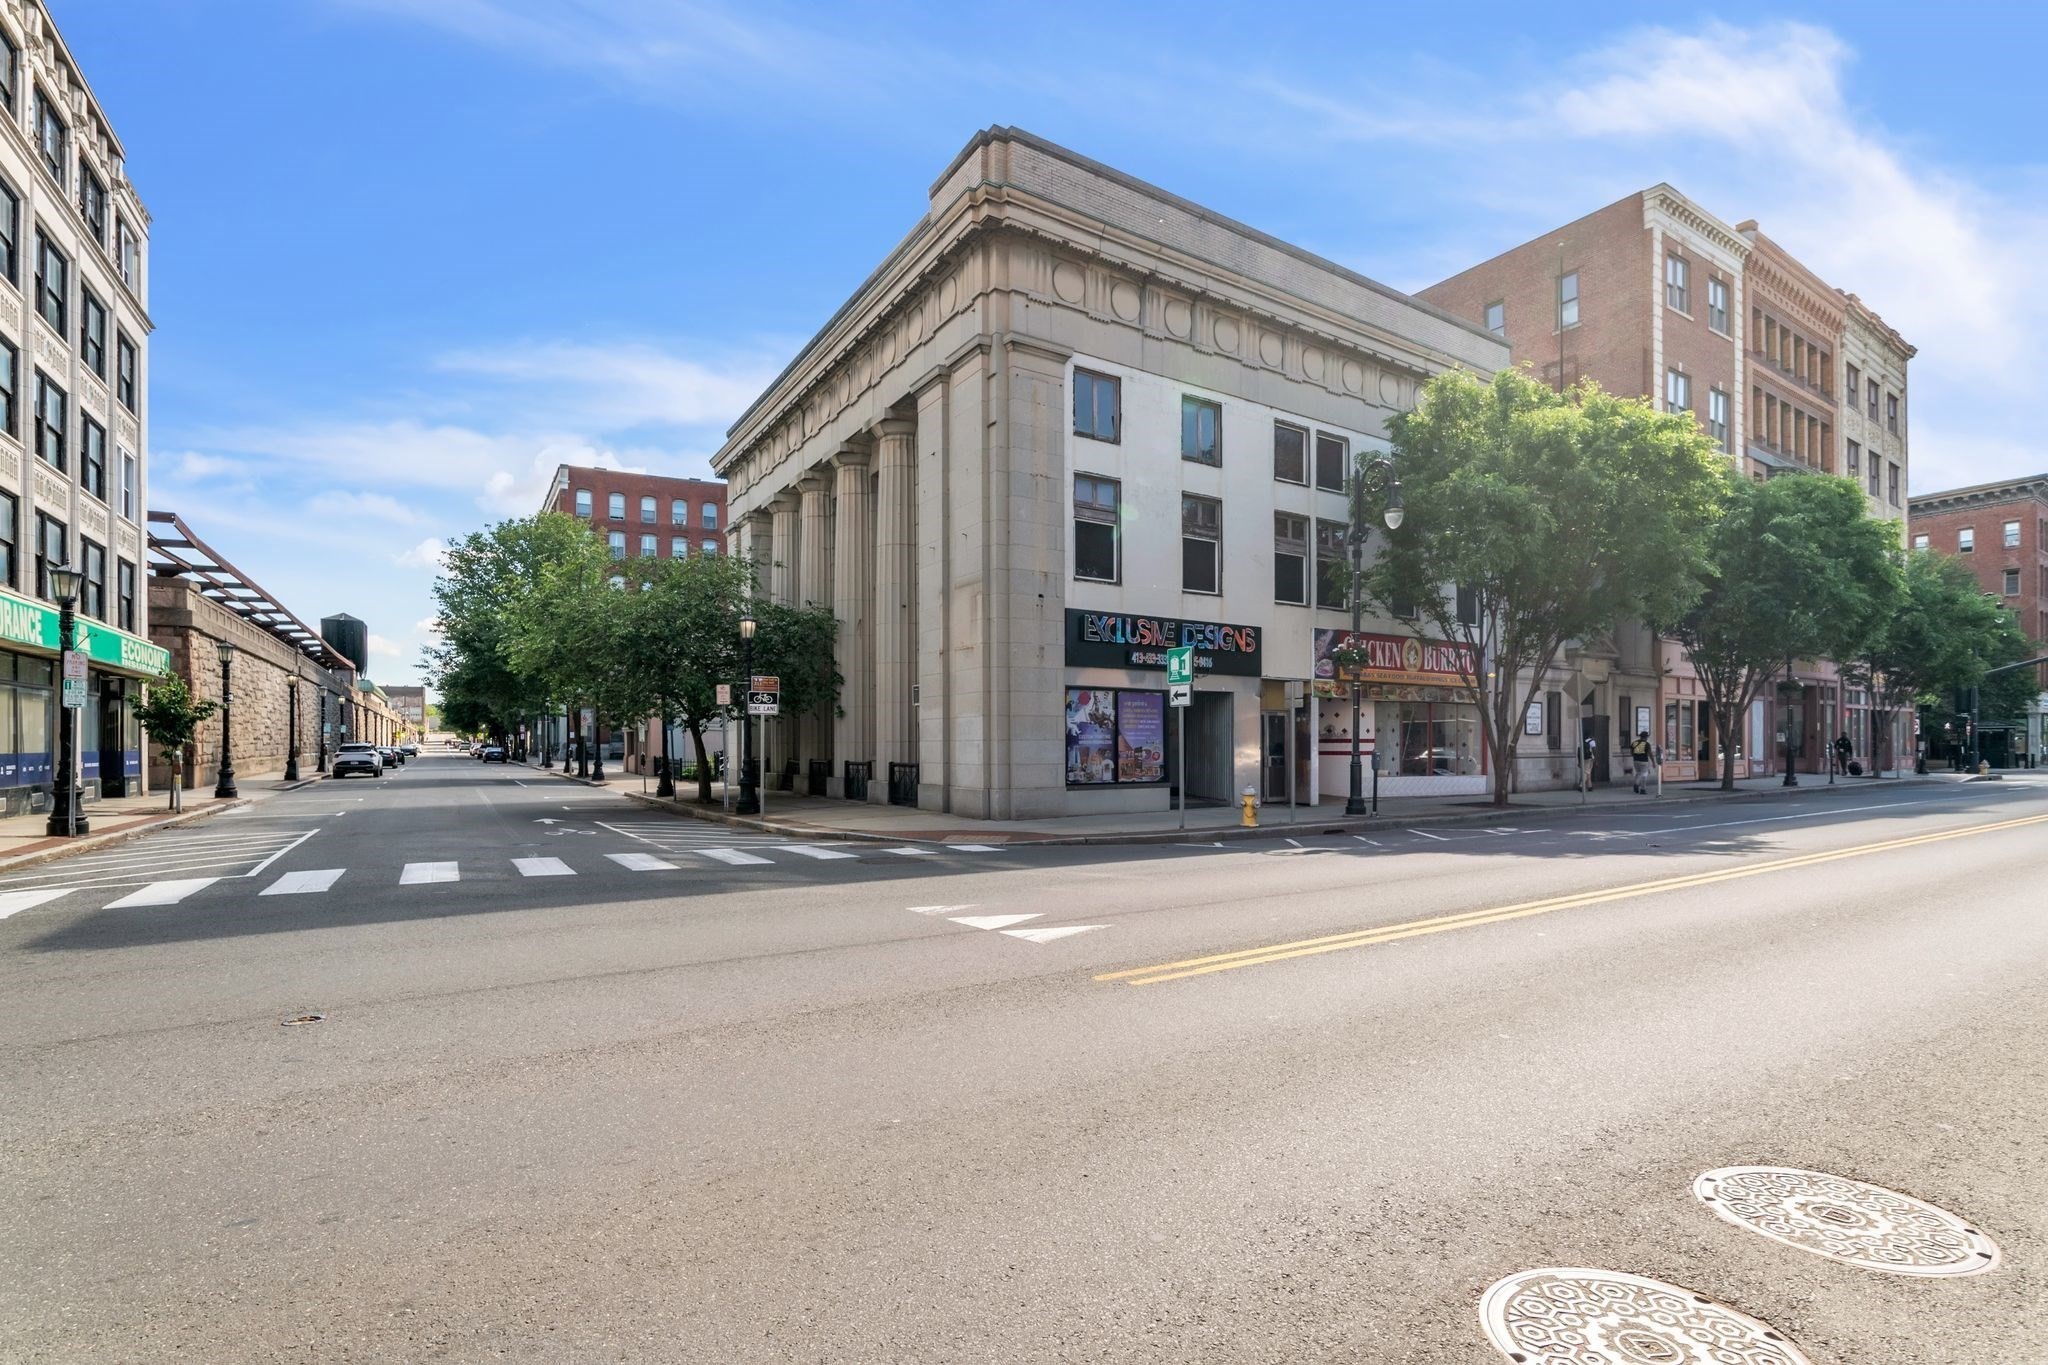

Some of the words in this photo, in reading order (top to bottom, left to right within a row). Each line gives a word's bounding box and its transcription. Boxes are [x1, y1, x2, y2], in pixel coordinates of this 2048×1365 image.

[1084, 614, 1176, 647] EXCLUSIVE
[1182, 622, 1256, 653] DESIGNS
[121, 637, 167, 669] ECONOMY
